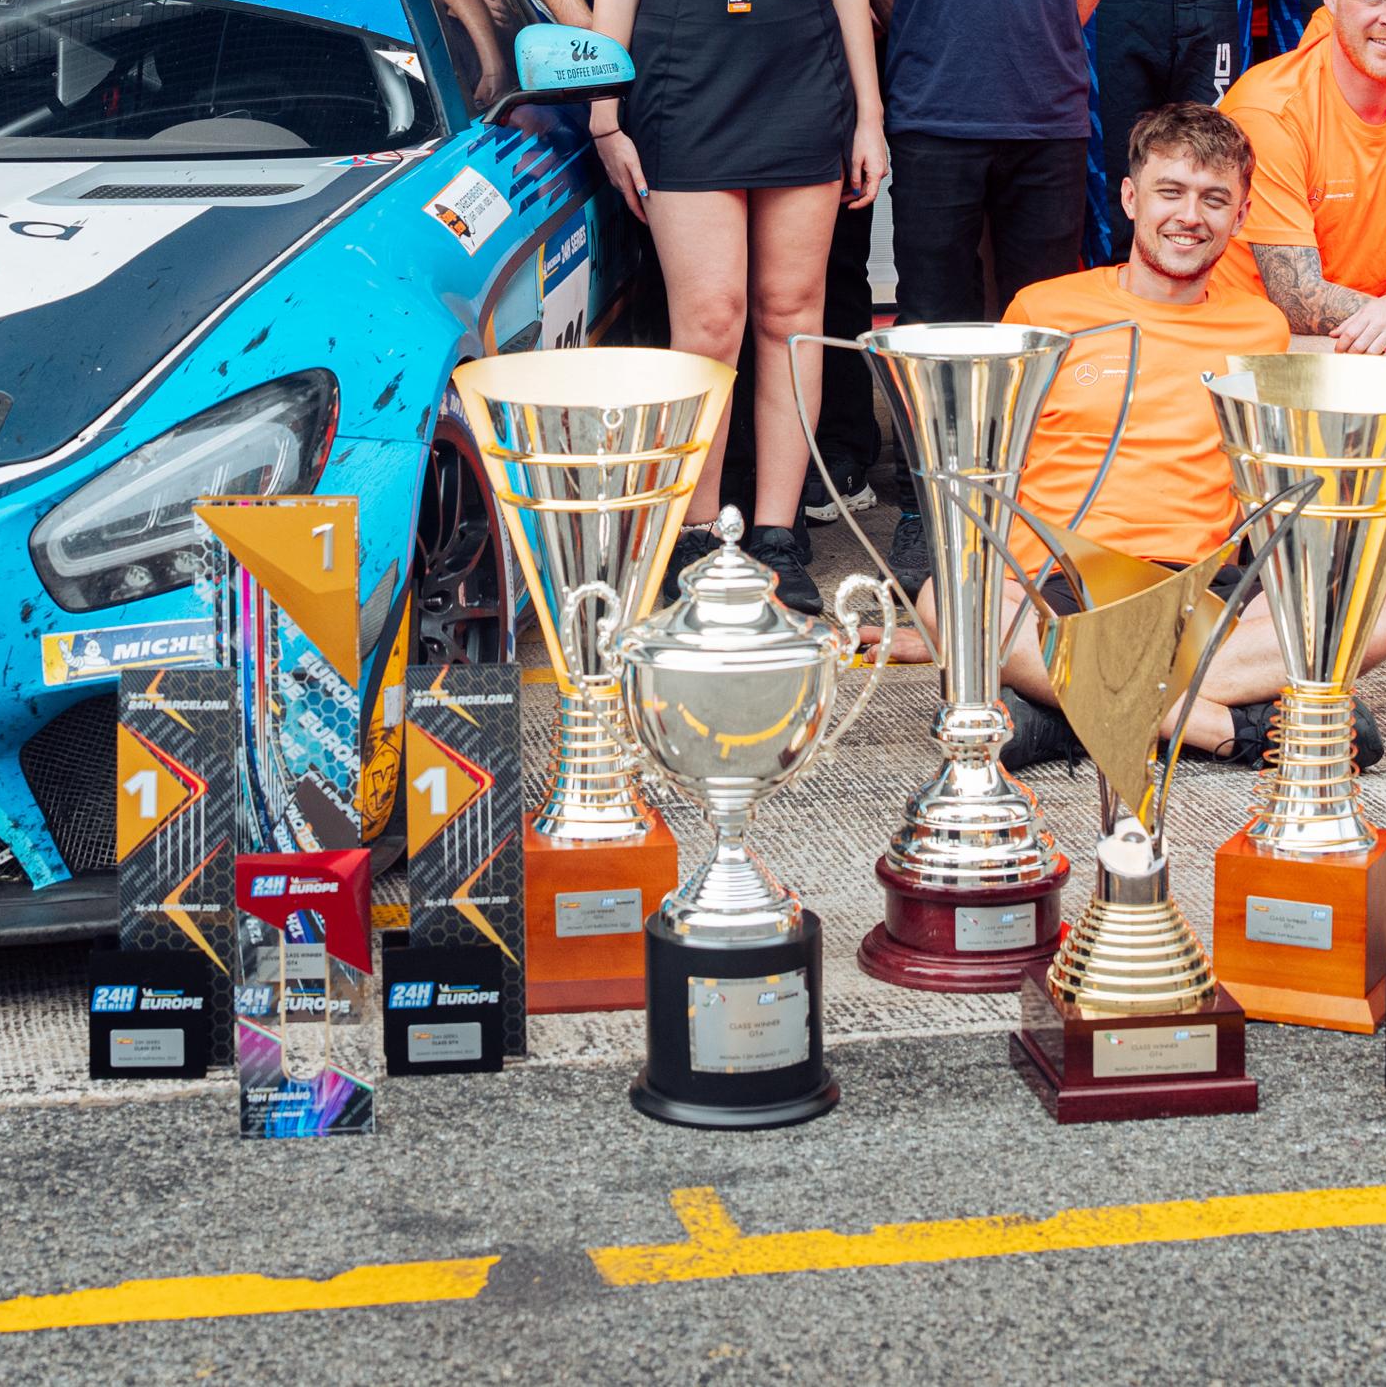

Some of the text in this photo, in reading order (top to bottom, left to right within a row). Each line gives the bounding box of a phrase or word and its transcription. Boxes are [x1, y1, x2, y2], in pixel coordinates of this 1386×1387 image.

[567, 67, 591, 79] COFFEE
[561, 244, 572, 264] 24H
[570, 225, 587, 256] SERIES
[312, 523, 335, 571] 1
[128, 699, 230, 711] 24H BARCELONA
[412, 694, 513, 708] 24H BARCELONA
[123, 770, 158, 819] 1
[412, 767, 448, 816] 1
[254, 876, 286, 891] 24H
[289, 882, 339, 895] EUROPE
[98, 988, 134, 1003] 24H
[393, 984, 430, 1000] 24H
[437, 991, 500, 1006] EUROPE
[95, 1001, 132, 1011] SERIES
[140, 997, 203, 1010] EUROPE
[392, 998, 429, 1007] SERIES
